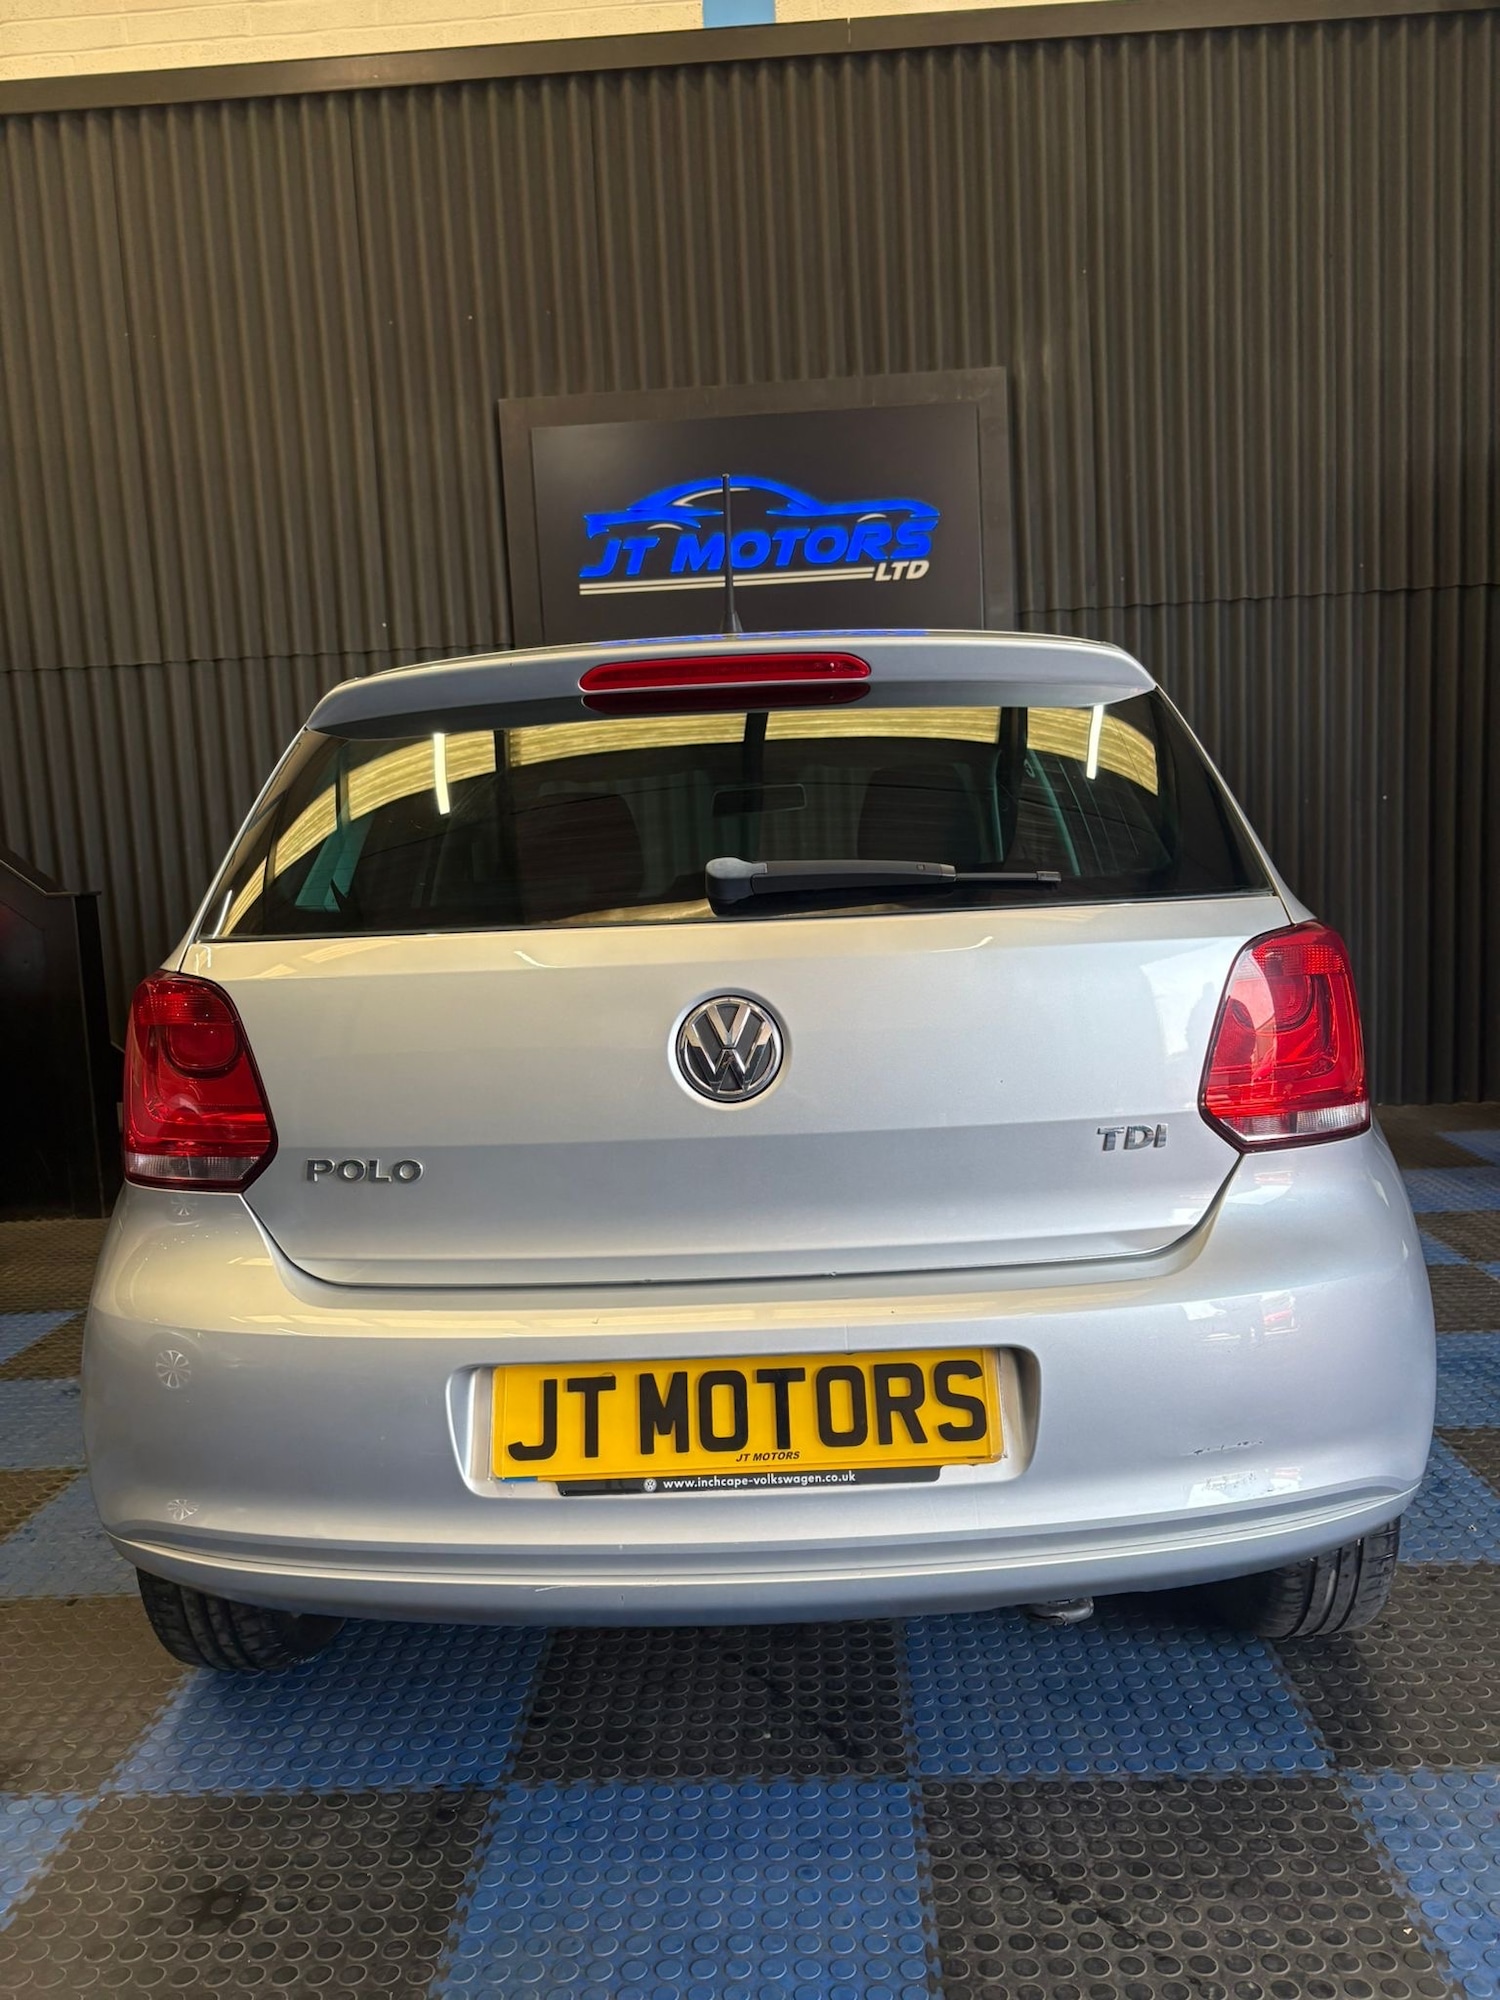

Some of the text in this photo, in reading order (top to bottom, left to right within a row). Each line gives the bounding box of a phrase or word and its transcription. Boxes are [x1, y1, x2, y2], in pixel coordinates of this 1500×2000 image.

[579, 519, 939, 578] JT MOTORS
[874, 560, 930, 582] LTD
[1096, 1123, 1168, 1152] TDI
[306, 1158, 424, 1184] POLO
[507, 1359, 988, 1462] JT MOTORS
[735, 1451, 801, 1463] JT MOTORS
[663, 1470, 856, 1490] www.inchcape-volkswagen.co.uk
